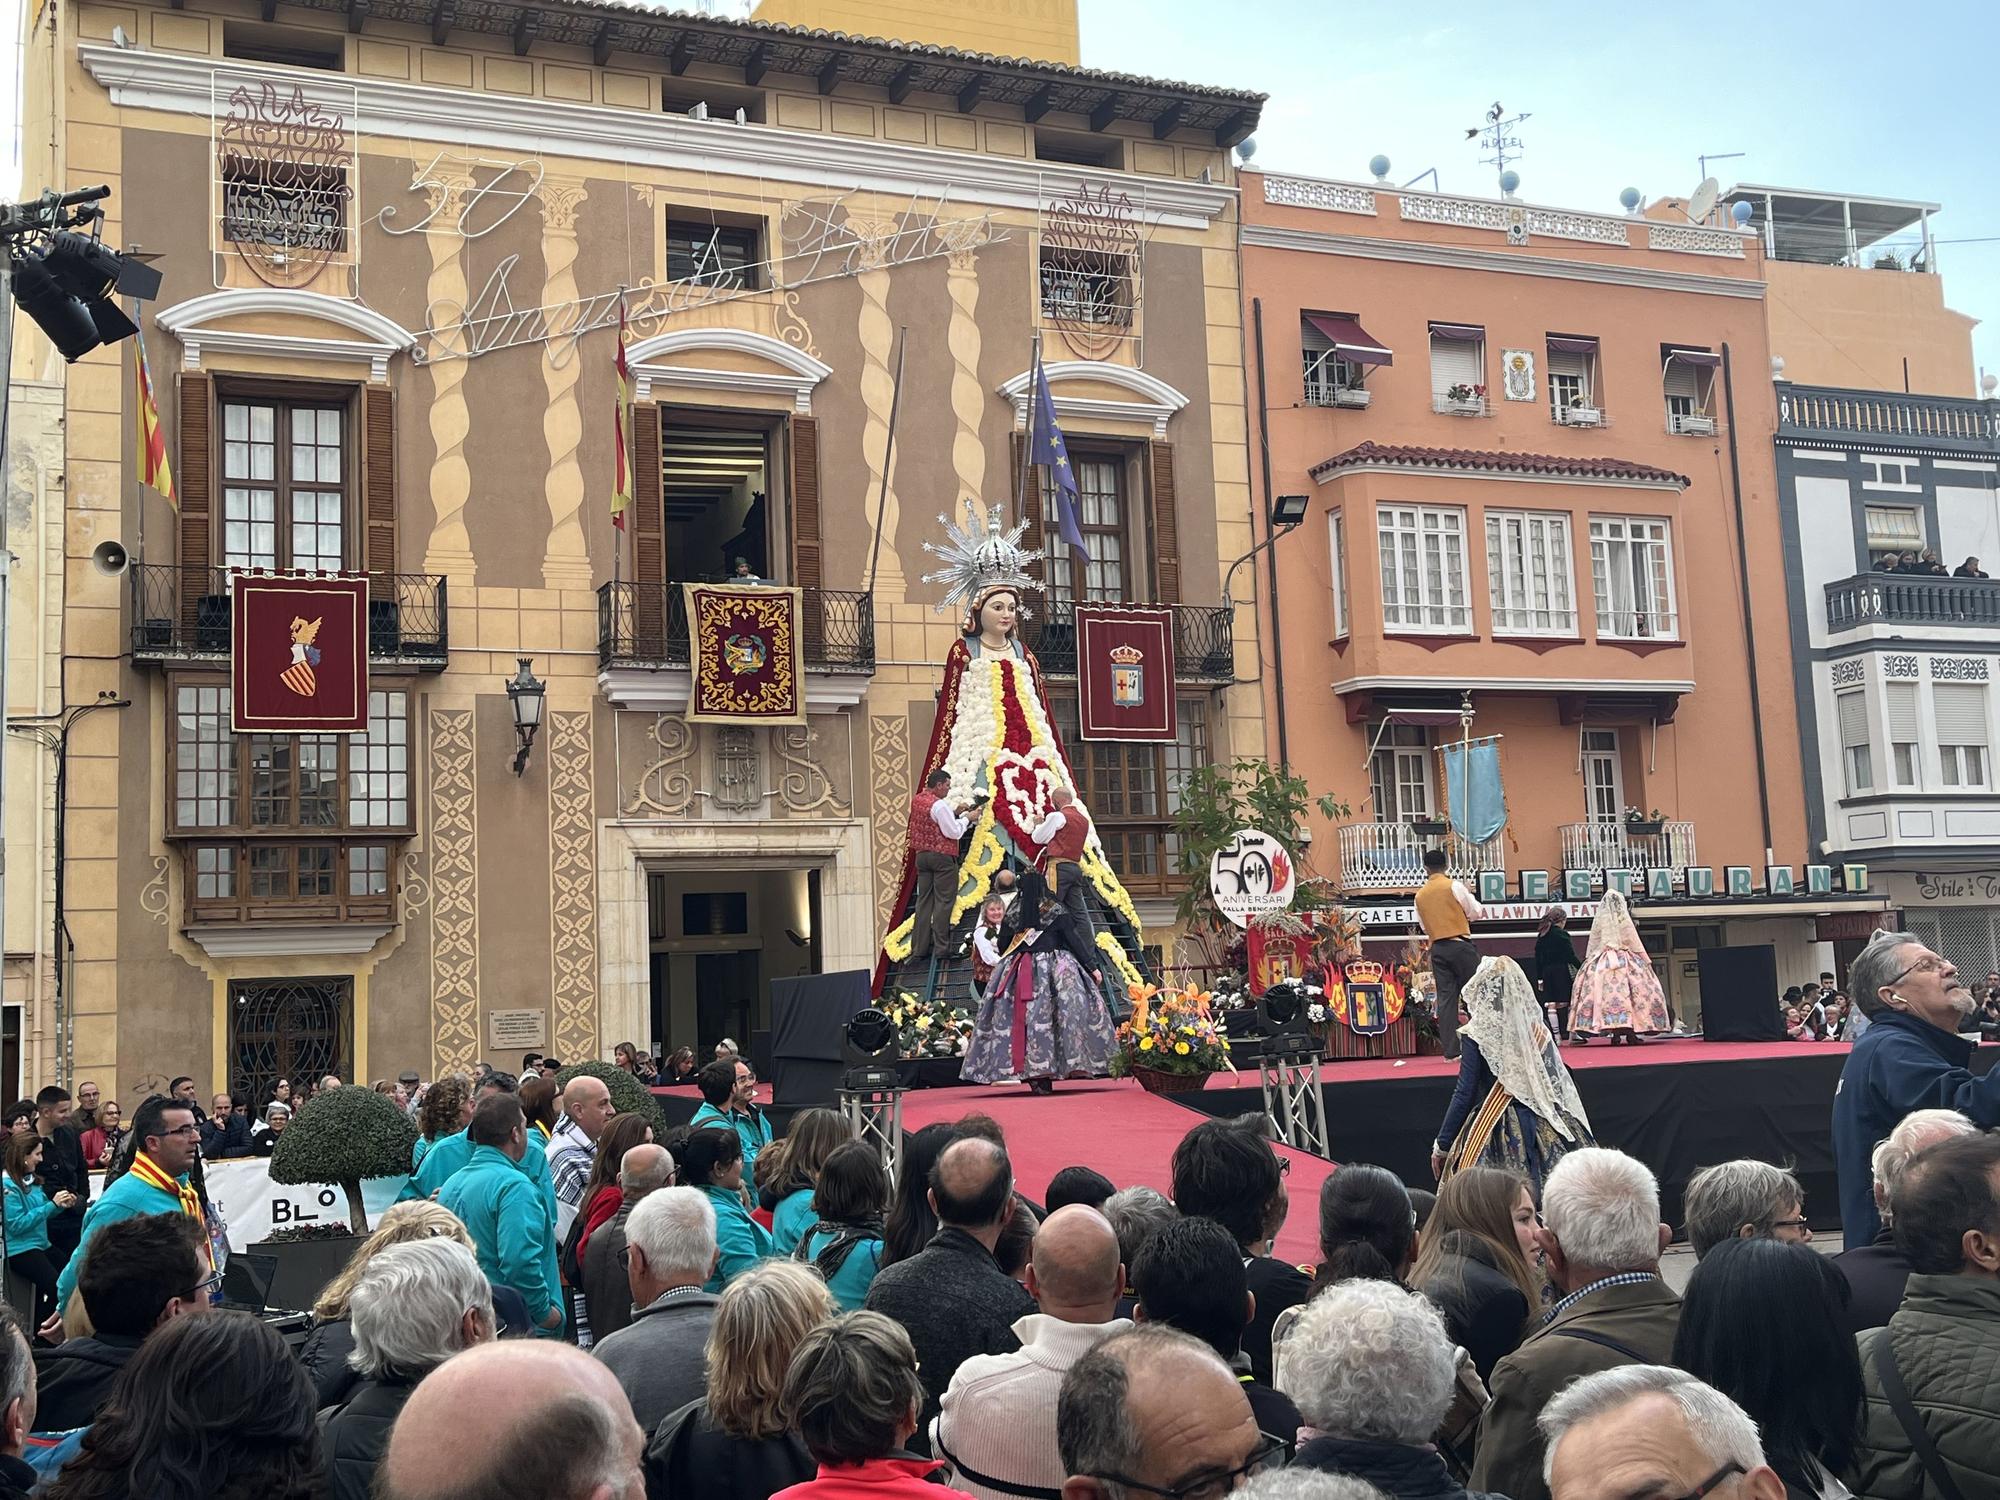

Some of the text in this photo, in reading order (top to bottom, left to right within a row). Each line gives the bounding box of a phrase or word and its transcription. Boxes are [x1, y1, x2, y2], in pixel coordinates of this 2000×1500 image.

[1481, 137, 1524, 149] HOTEL
[379, 151, 544, 238] 50
[1483, 867, 1867, 900] RESTAURANT
[1920, 876, 1964, 900] Stile
[1222, 895, 1286, 904] ANIVERSARI
